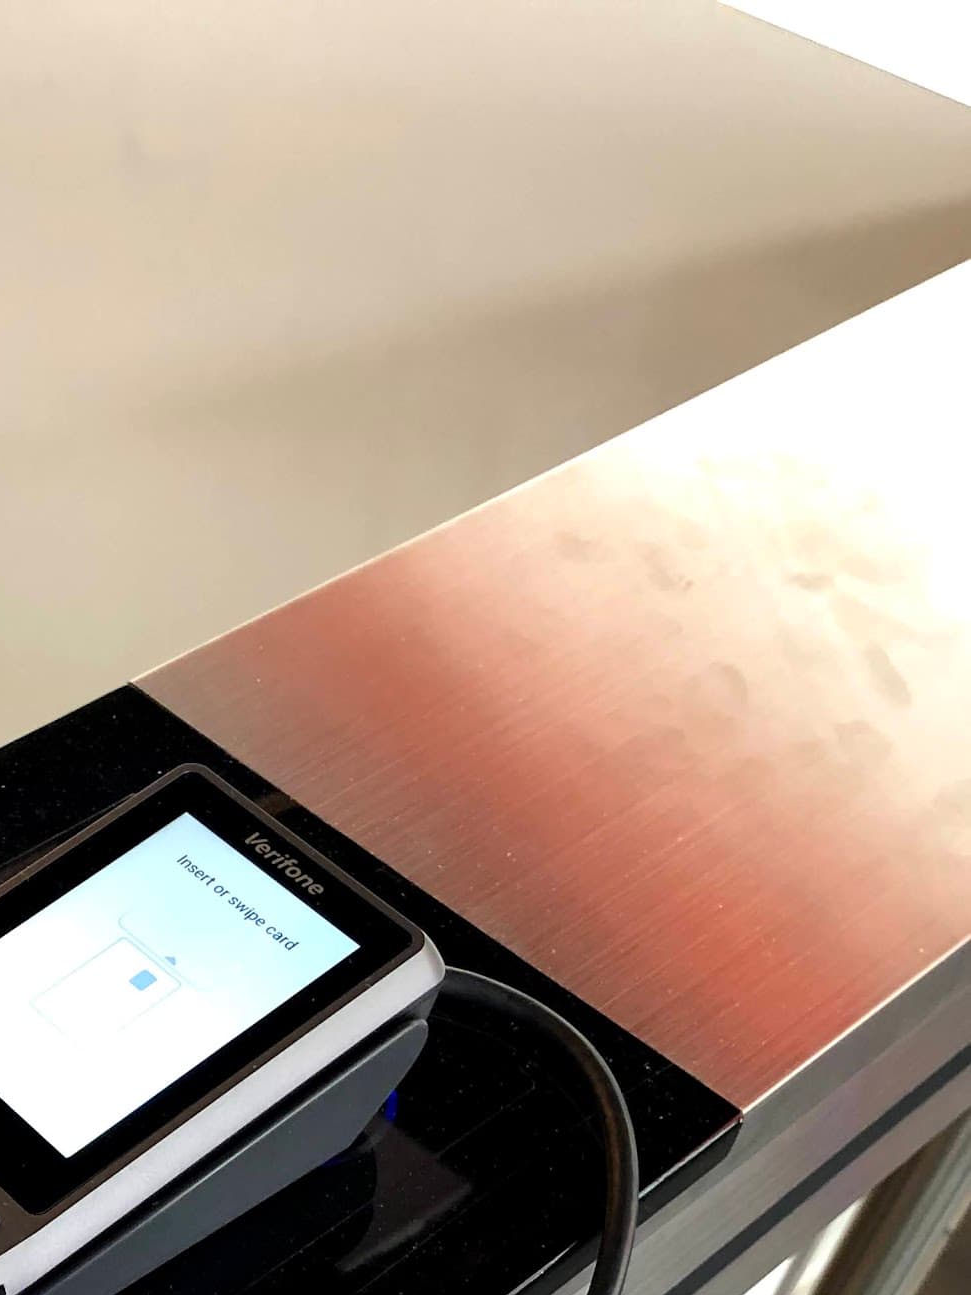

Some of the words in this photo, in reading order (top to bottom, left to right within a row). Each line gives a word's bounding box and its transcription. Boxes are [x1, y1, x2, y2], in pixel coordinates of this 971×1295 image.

[176, 854, 214, 886] Insert
[213, 884, 230, 898] or
[228, 895, 266, 927] swipe
[265, 925, 299, 951] card
[245, 832, 325, 895] Verifone
